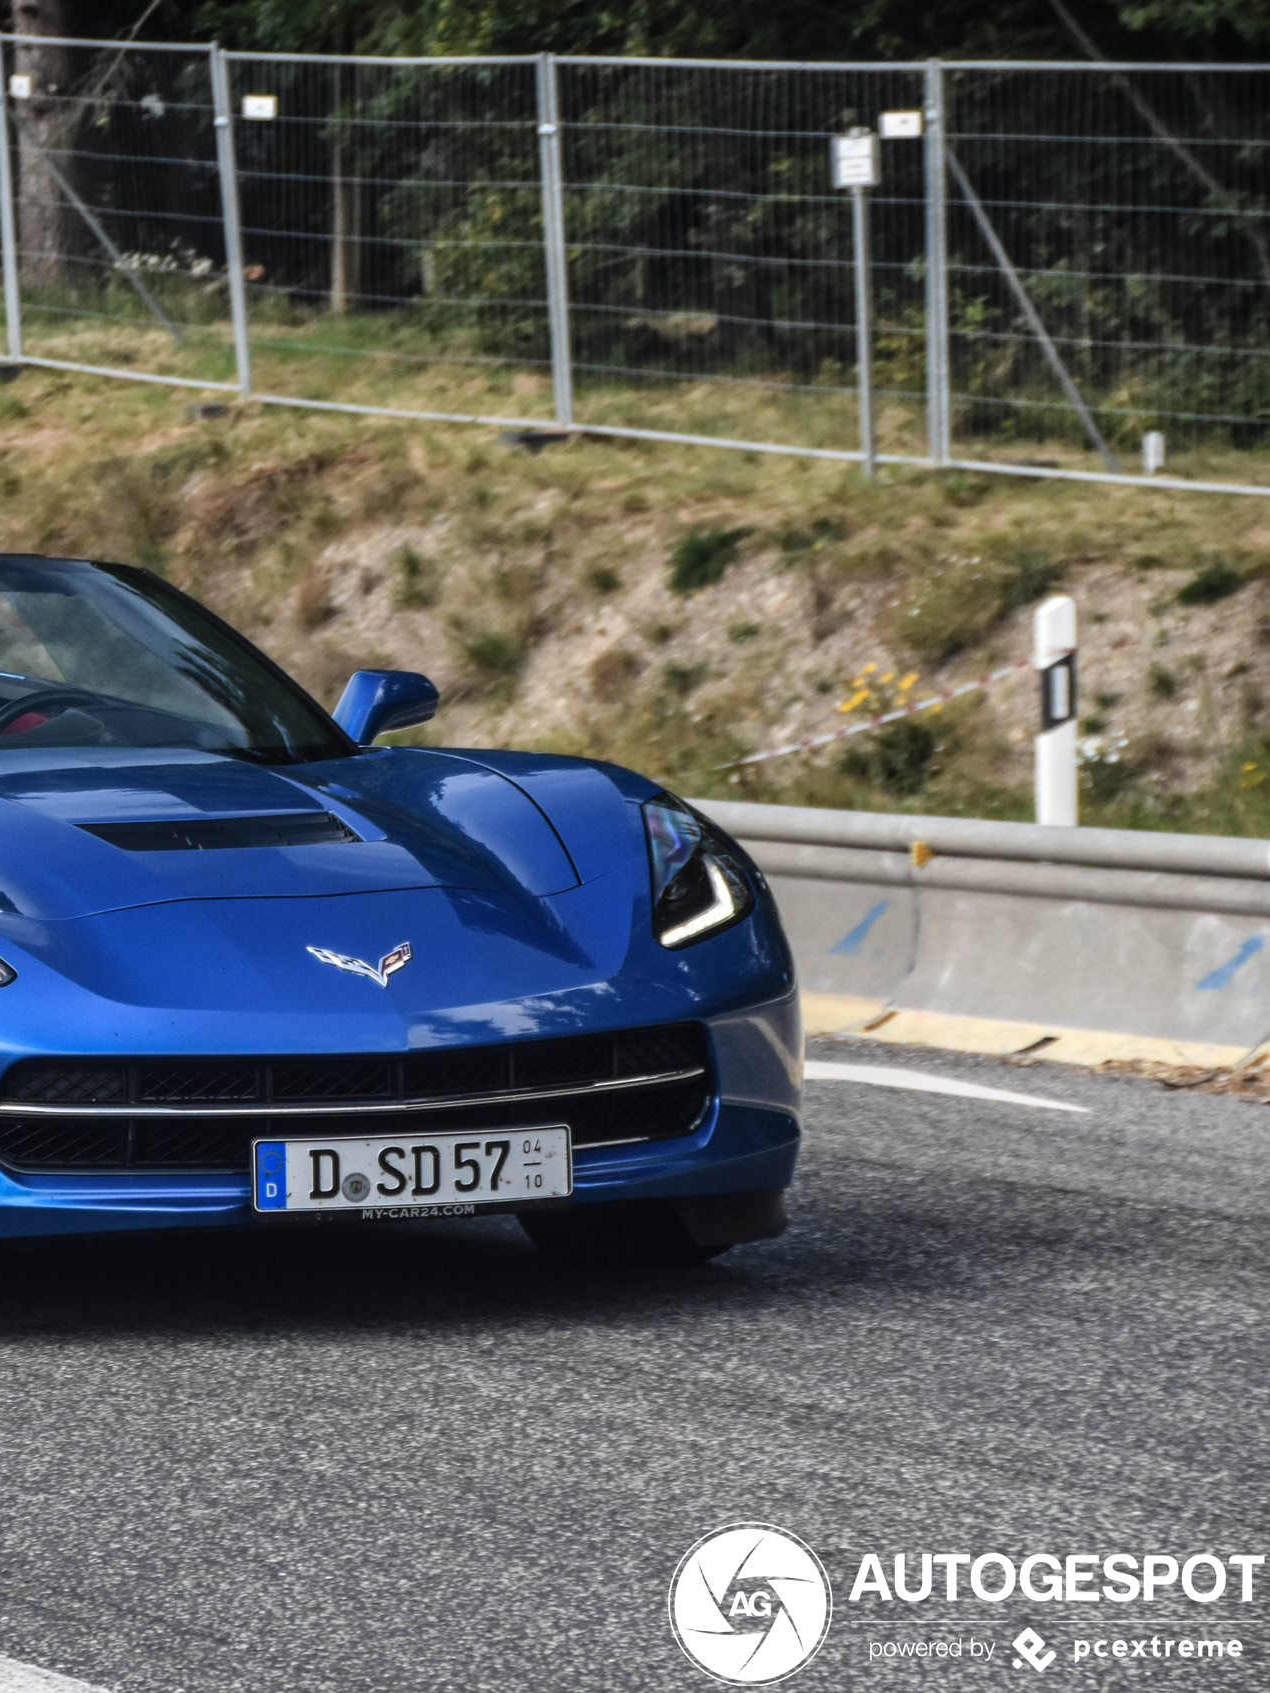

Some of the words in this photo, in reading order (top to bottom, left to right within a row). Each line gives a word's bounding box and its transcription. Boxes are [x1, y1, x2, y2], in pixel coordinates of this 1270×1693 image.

[522, 1139, 542, 1154] 04
[308, 1148, 341, 1200] D
[376, 1145, 441, 1198] SD
[454, 1140, 511, 1193] 57
[525, 1173, 543, 1189] 10
[266, 1183, 278, 1199] D
[362, 1204, 476, 1220] MY-CAR24.COM
